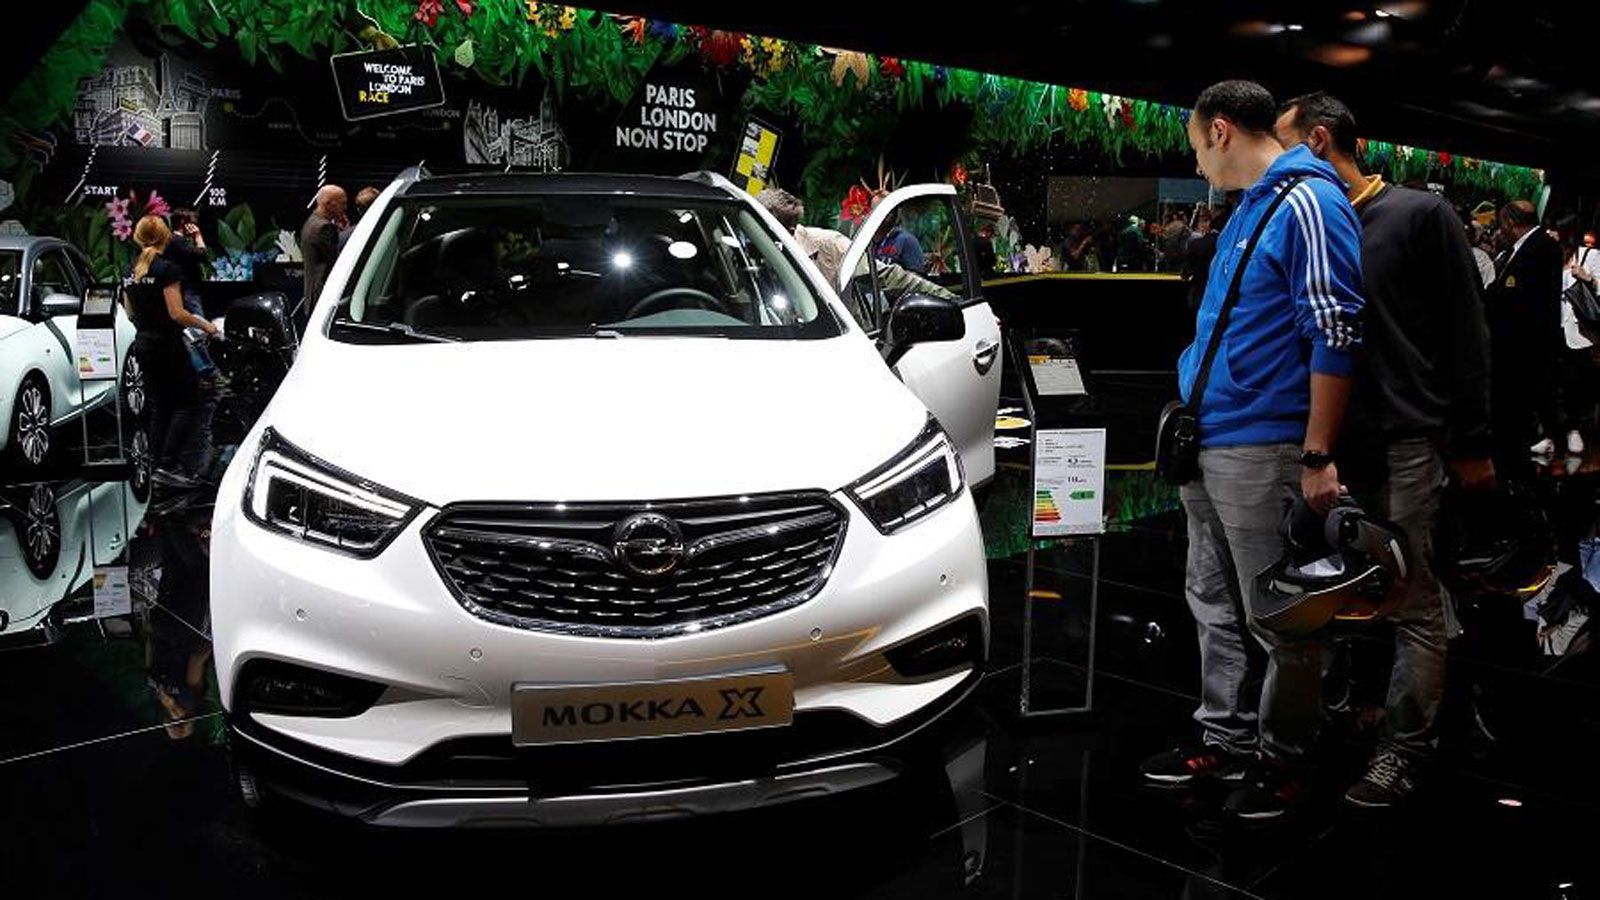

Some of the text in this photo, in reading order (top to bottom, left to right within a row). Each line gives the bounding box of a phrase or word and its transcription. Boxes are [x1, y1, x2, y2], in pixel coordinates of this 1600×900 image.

[363, 62, 413, 76] WELCOME
[383, 74, 425, 86] TO PARIS
[369, 81, 412, 95] LONDON
[358, 90, 390, 104] RACE
[645, 83, 696, 108] PARIS
[640, 106, 717, 132] LONDON
[616, 126, 708, 153] NON STOP
[84, 186, 119, 196] START
[209, 197, 227, 207] KM
[542, 686, 765, 727] MOKKA X
